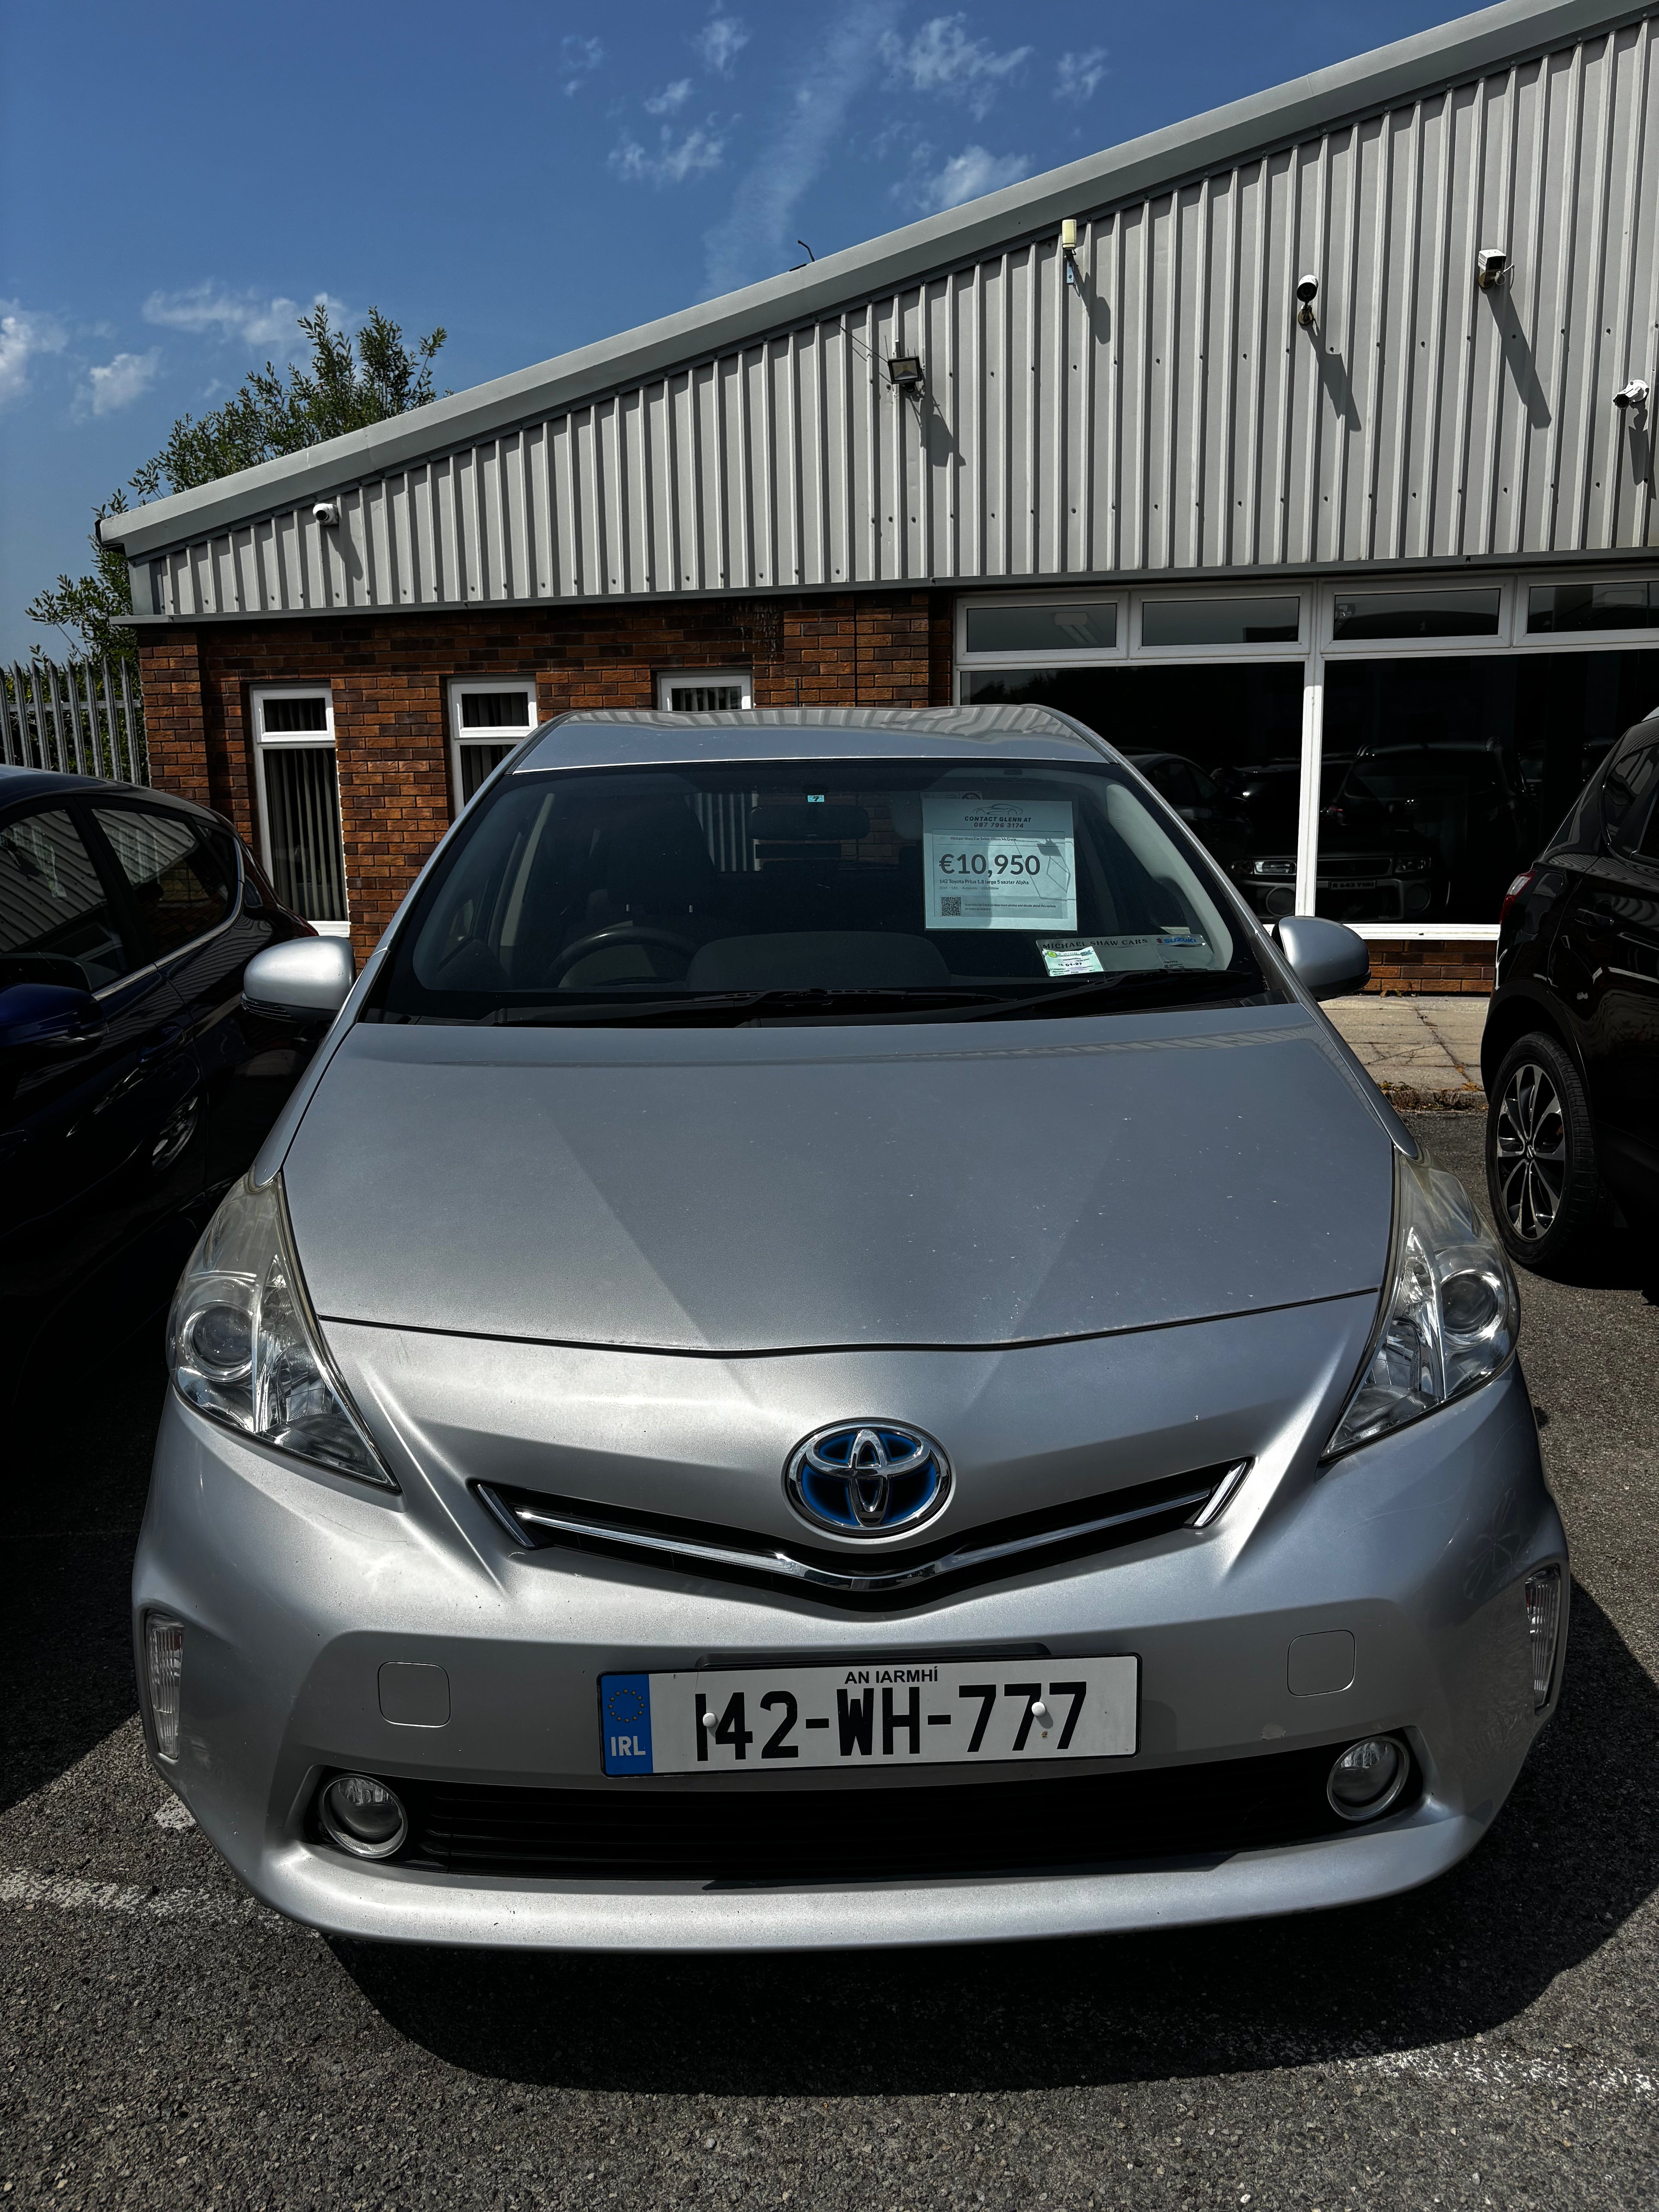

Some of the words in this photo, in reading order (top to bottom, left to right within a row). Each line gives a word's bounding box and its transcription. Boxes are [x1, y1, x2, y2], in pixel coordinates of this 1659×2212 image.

[939, 854, 1040, 878] €10,950
[845, 1671, 871, 1684] AN
[876, 1665, 939, 1684] IARMHÍ
[696, 1681, 1087, 1762] 142-WH-777
[610, 1735, 646, 1757] IRL
